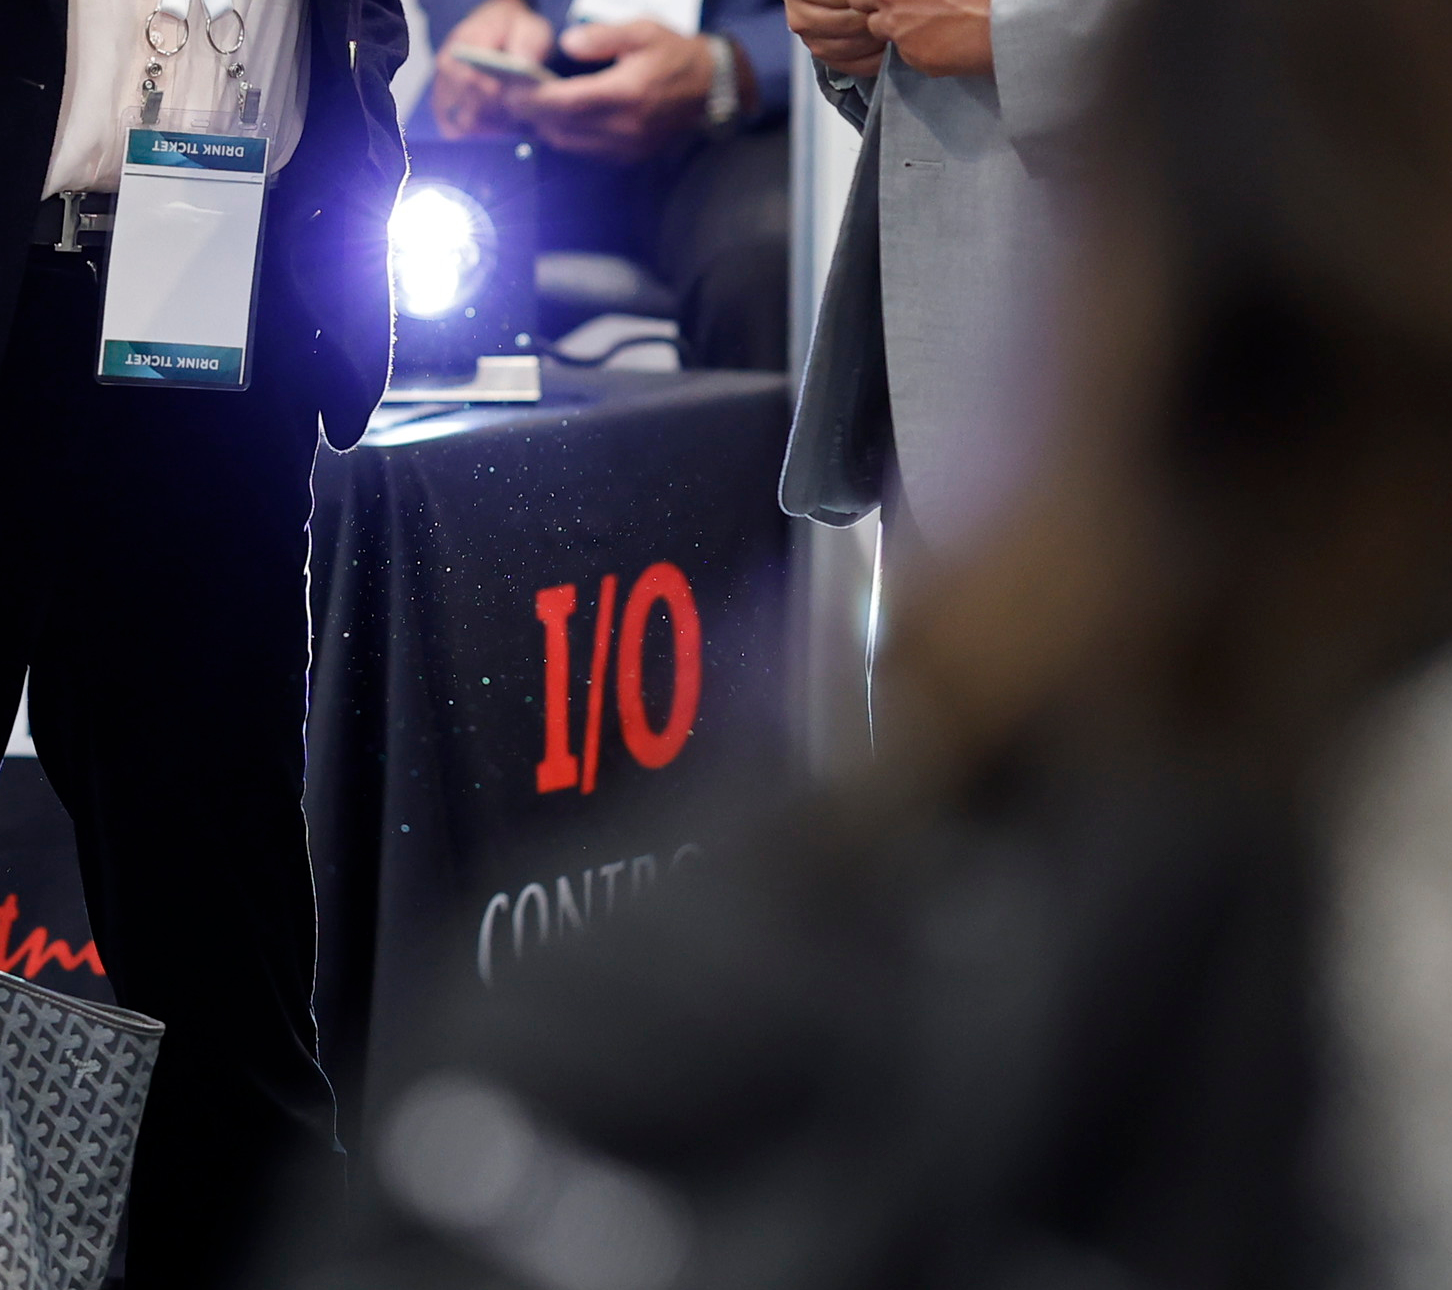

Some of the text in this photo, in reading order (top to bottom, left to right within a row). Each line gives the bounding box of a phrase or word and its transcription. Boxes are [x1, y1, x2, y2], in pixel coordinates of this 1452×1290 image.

[151, 139, 245, 158] DRINK TICKET
[124, 353, 219, 371] DRINK TICKET
[534, 561, 702, 796] I/O
